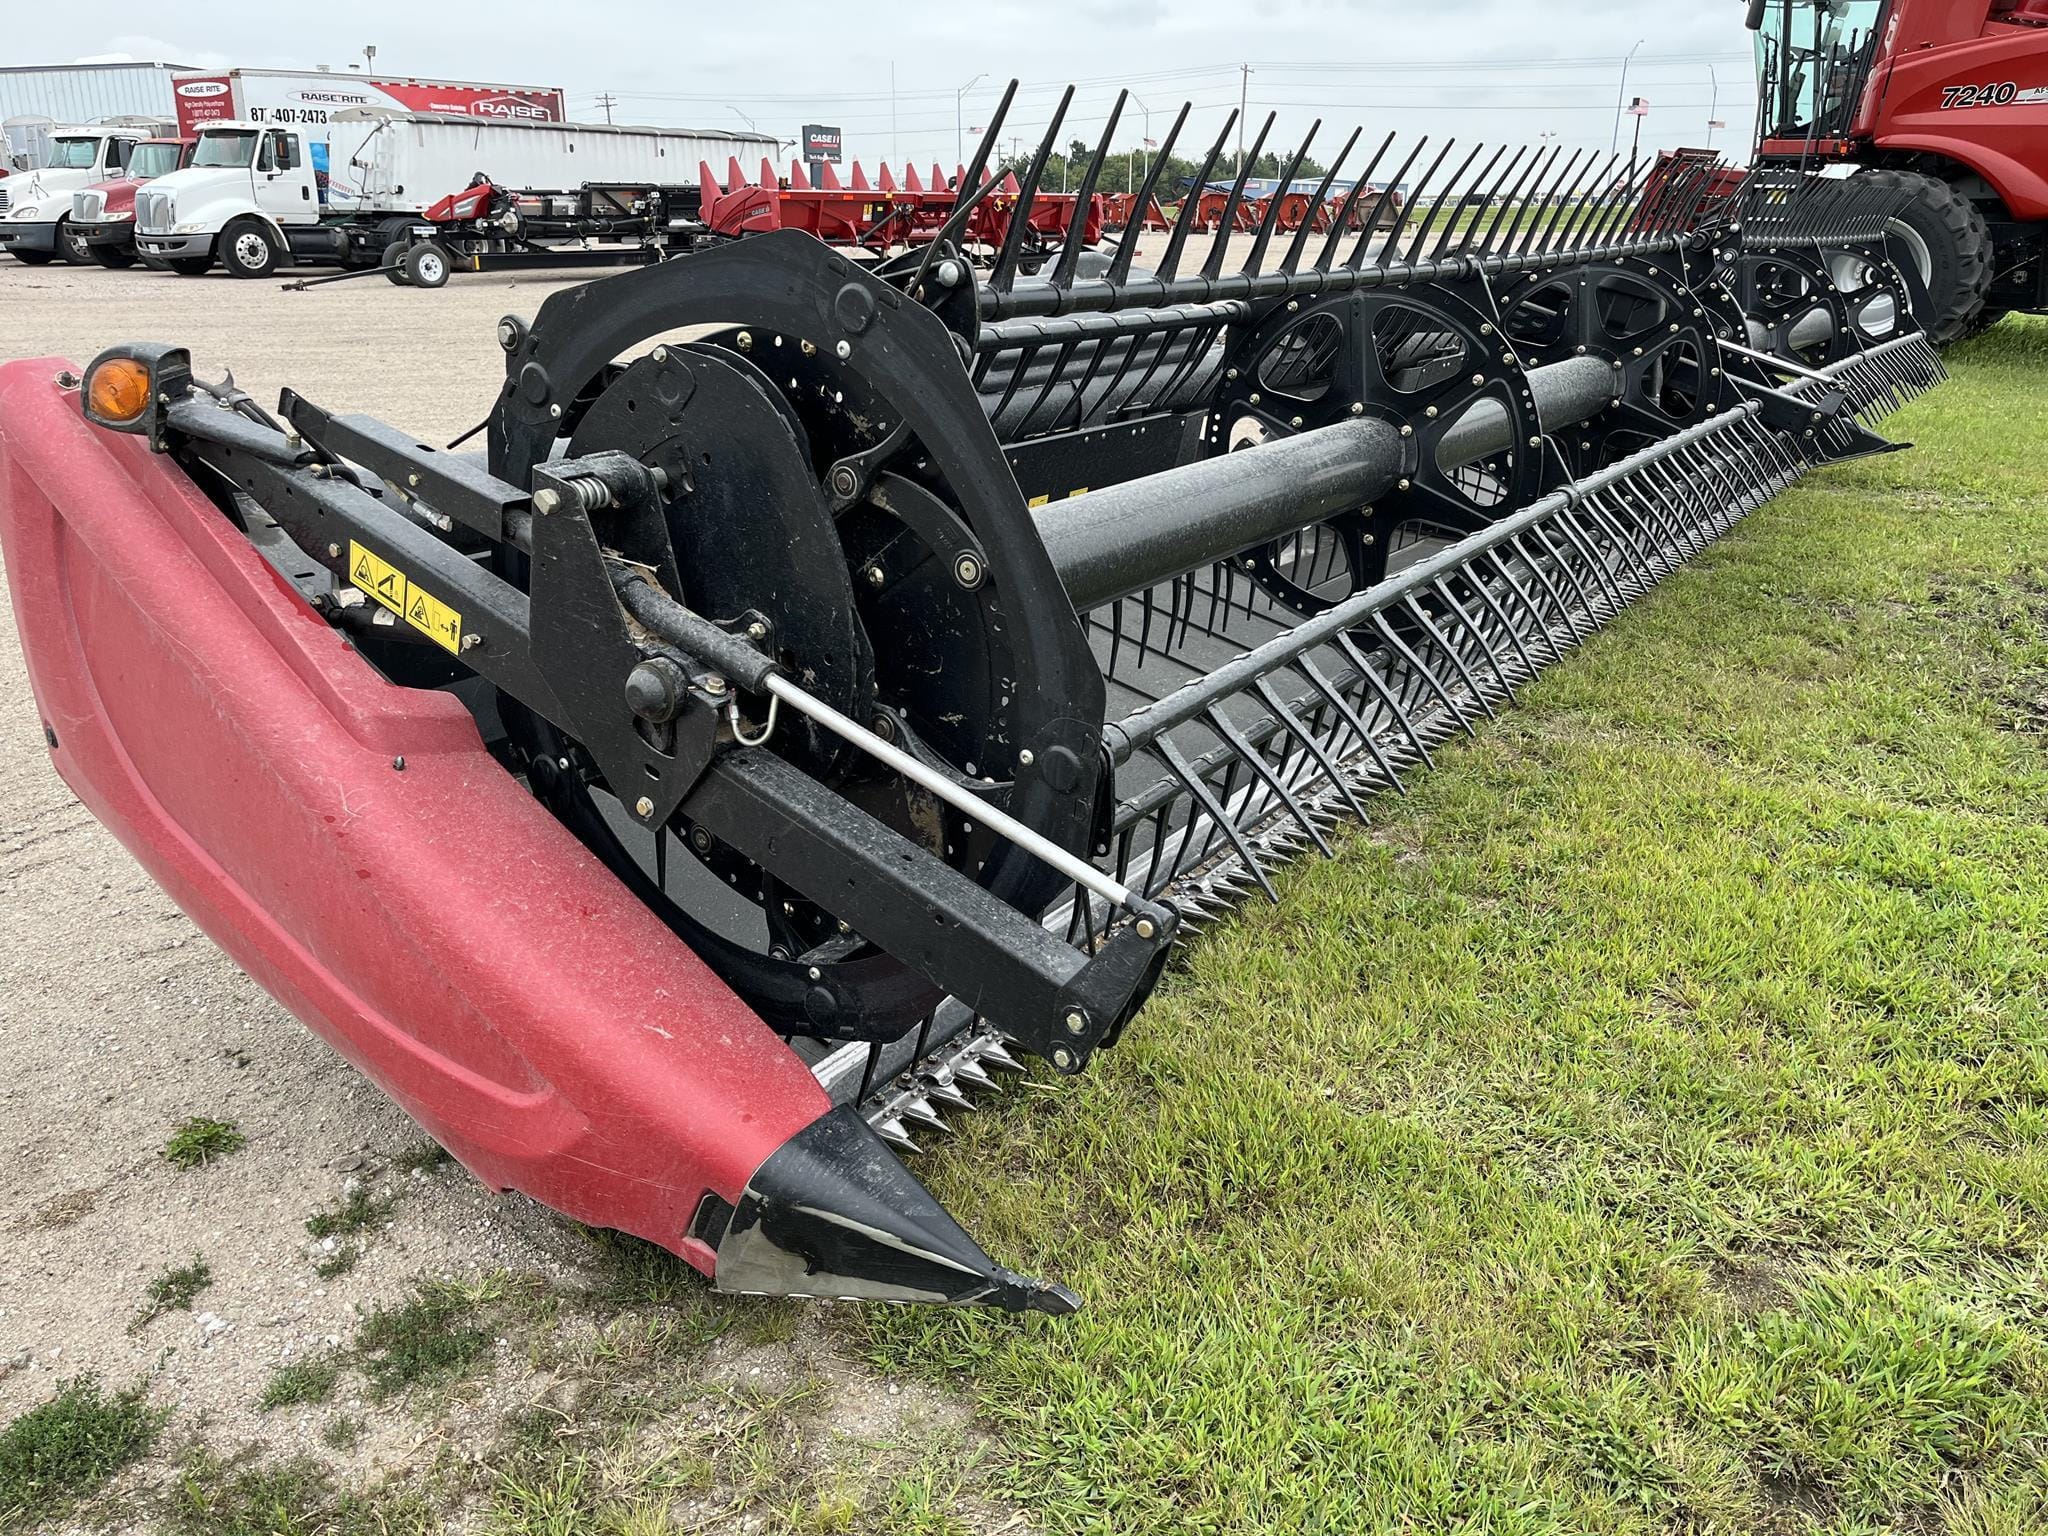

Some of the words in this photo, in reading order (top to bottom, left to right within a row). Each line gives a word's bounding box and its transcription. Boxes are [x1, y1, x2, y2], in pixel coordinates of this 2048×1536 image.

[184, 86, 205, 94] RAISE
[205, 85, 221, 93] RITE
[1940, 81, 2016, 109] 7240
[301, 92, 338, 102] RAISE
[341, 95, 368, 104] RITE
[250, 107, 328, 124] 87-407-2473
[479, 102, 545, 118] RAISE
[810, 133, 833, 144] CASE
